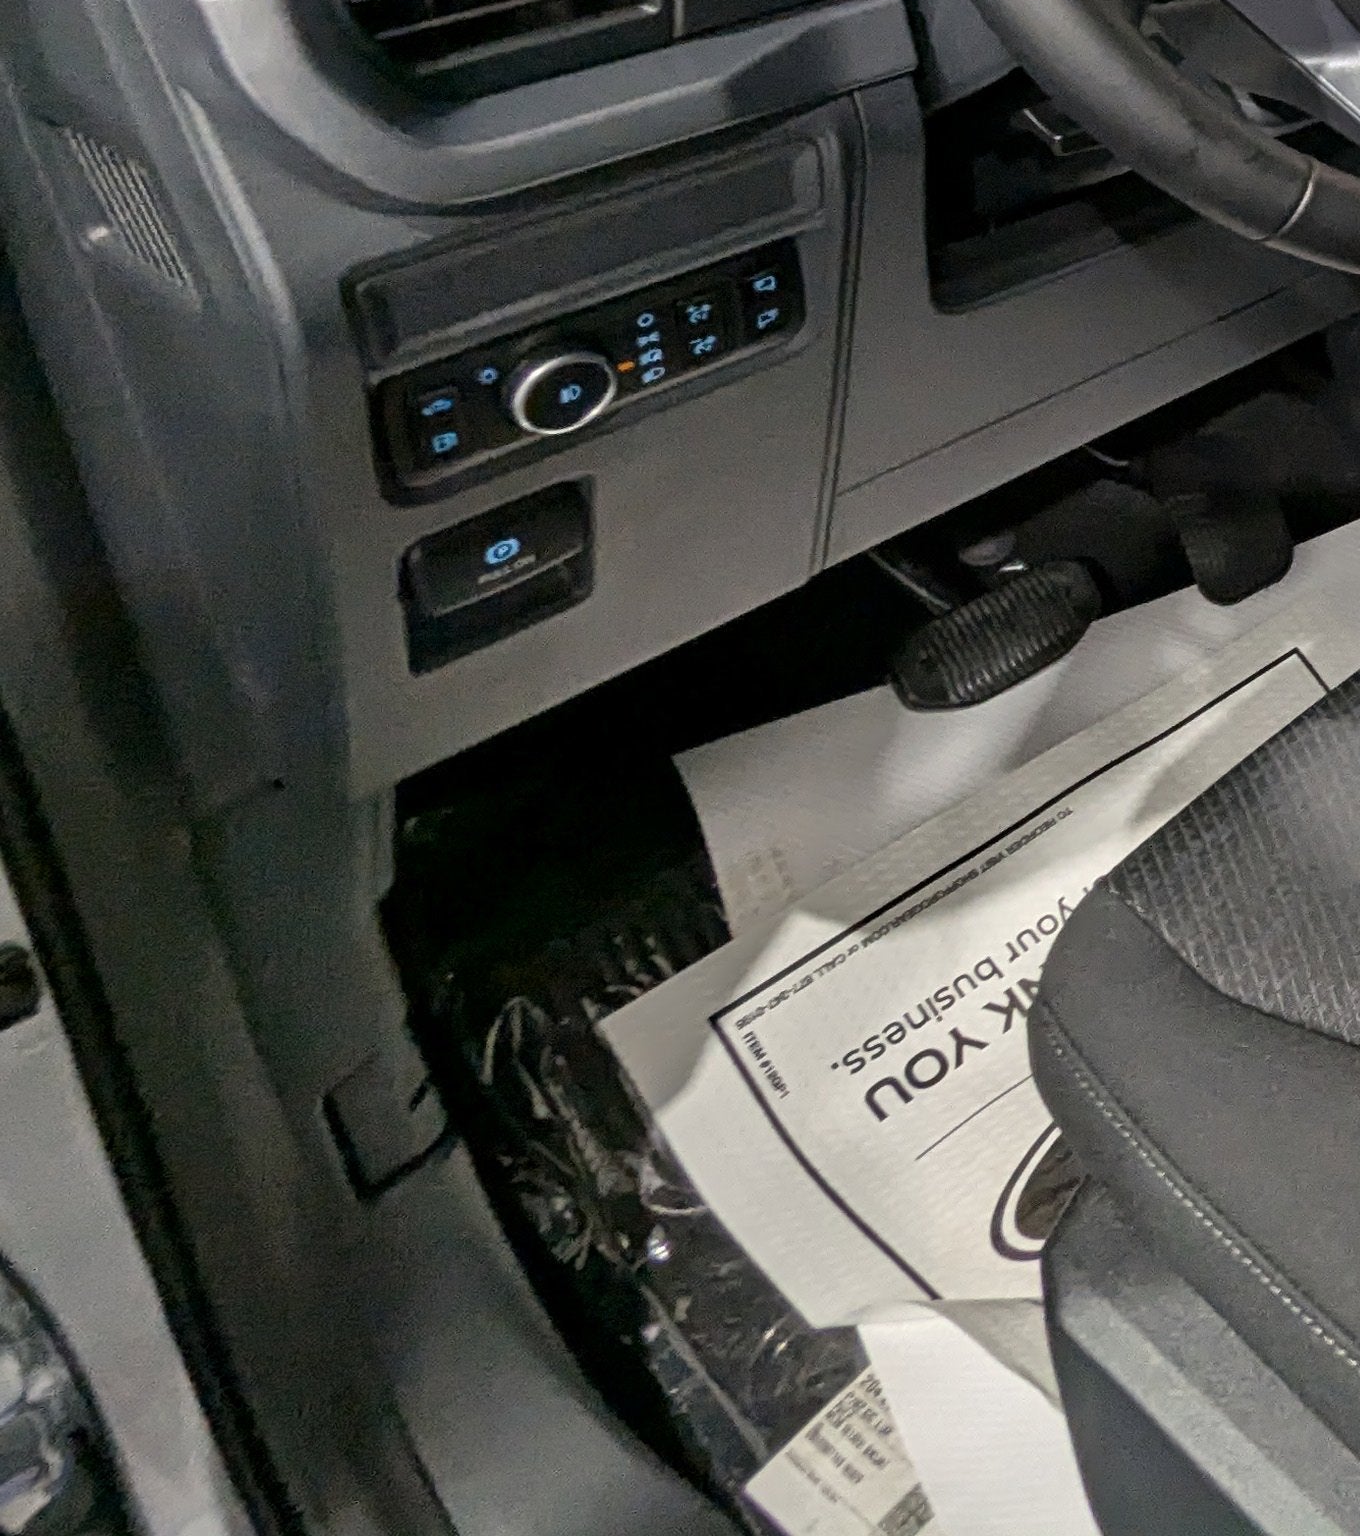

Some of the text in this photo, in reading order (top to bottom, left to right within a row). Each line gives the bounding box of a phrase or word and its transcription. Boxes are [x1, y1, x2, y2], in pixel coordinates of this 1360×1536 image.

[830, 895, 1074, 1076] your business.
[864, 1026, 990, 1123] YOU
